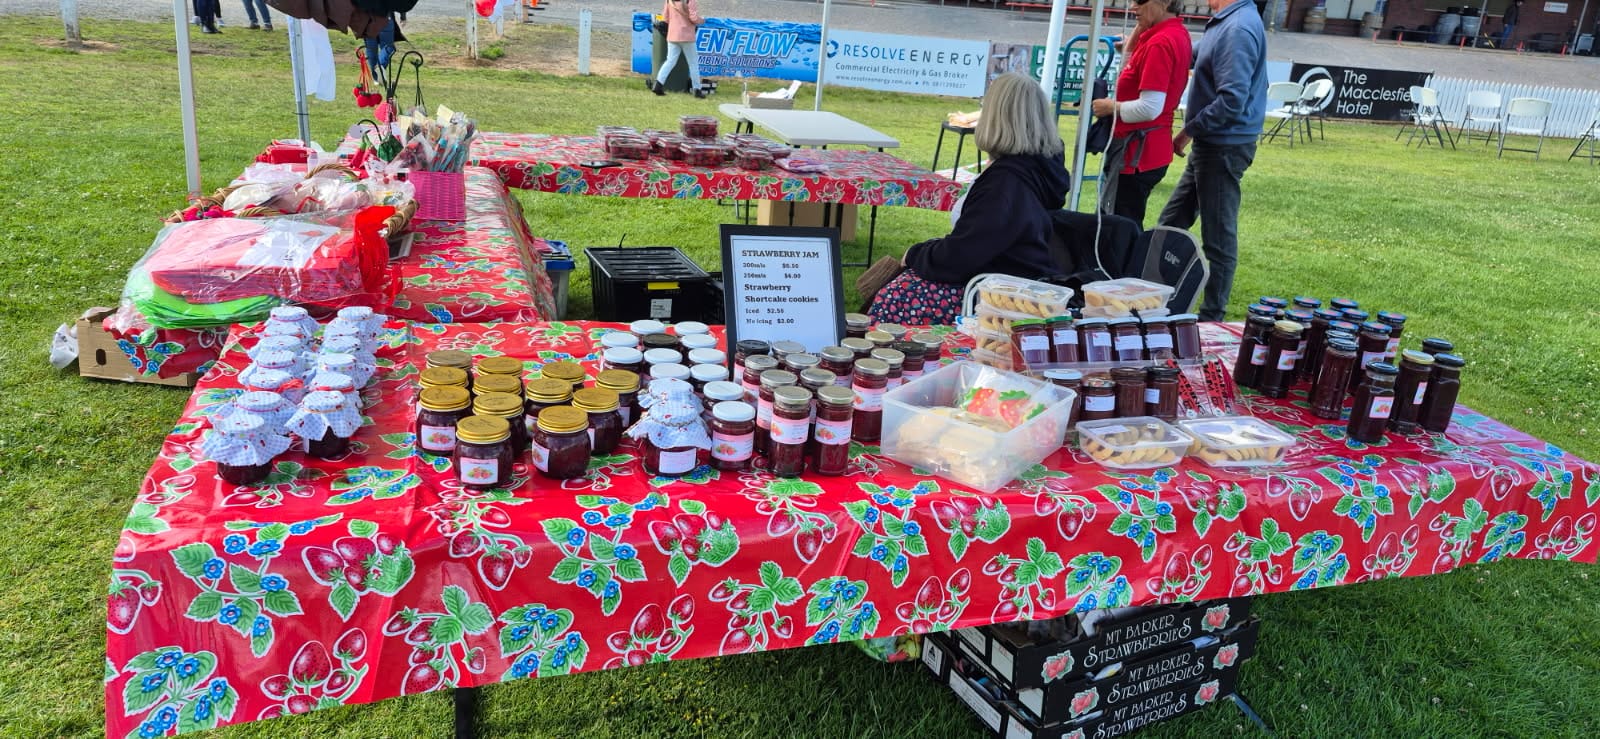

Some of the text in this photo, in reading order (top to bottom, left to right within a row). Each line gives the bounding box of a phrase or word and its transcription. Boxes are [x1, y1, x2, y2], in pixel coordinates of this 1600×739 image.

[696, 27, 798, 58] EN FLOW
[698, 56, 776, 69] MBING SOLUTIONS
[835, 62, 879, 73] Commercial
[881, 65, 919, 77] Electricity
[929, 69, 942, 78] Gas
[943, 70, 968, 79] Broker
[1343, 69, 1367, 85] The
[1339, 85, 1411, 102] Macclesfie
[1336, 100, 1373, 115] Hotel
[741, 250, 800, 258] STRAWBERRY
[744, 283, 791, 292] Strawberry
[745, 295, 819, 303] Shortcake cookies
[1105, 614, 1175, 646] MT BARKER
[1083, 617, 1192, 668] STRAWBERRIES
[1128, 652, 1191, 683] MT BARKER
[1107, 656, 1205, 704] STRAWBERRIES
[1113, 691, 1174, 722] MT BARKER
[1092, 692, 1187, 739] STRAWBERRIES
